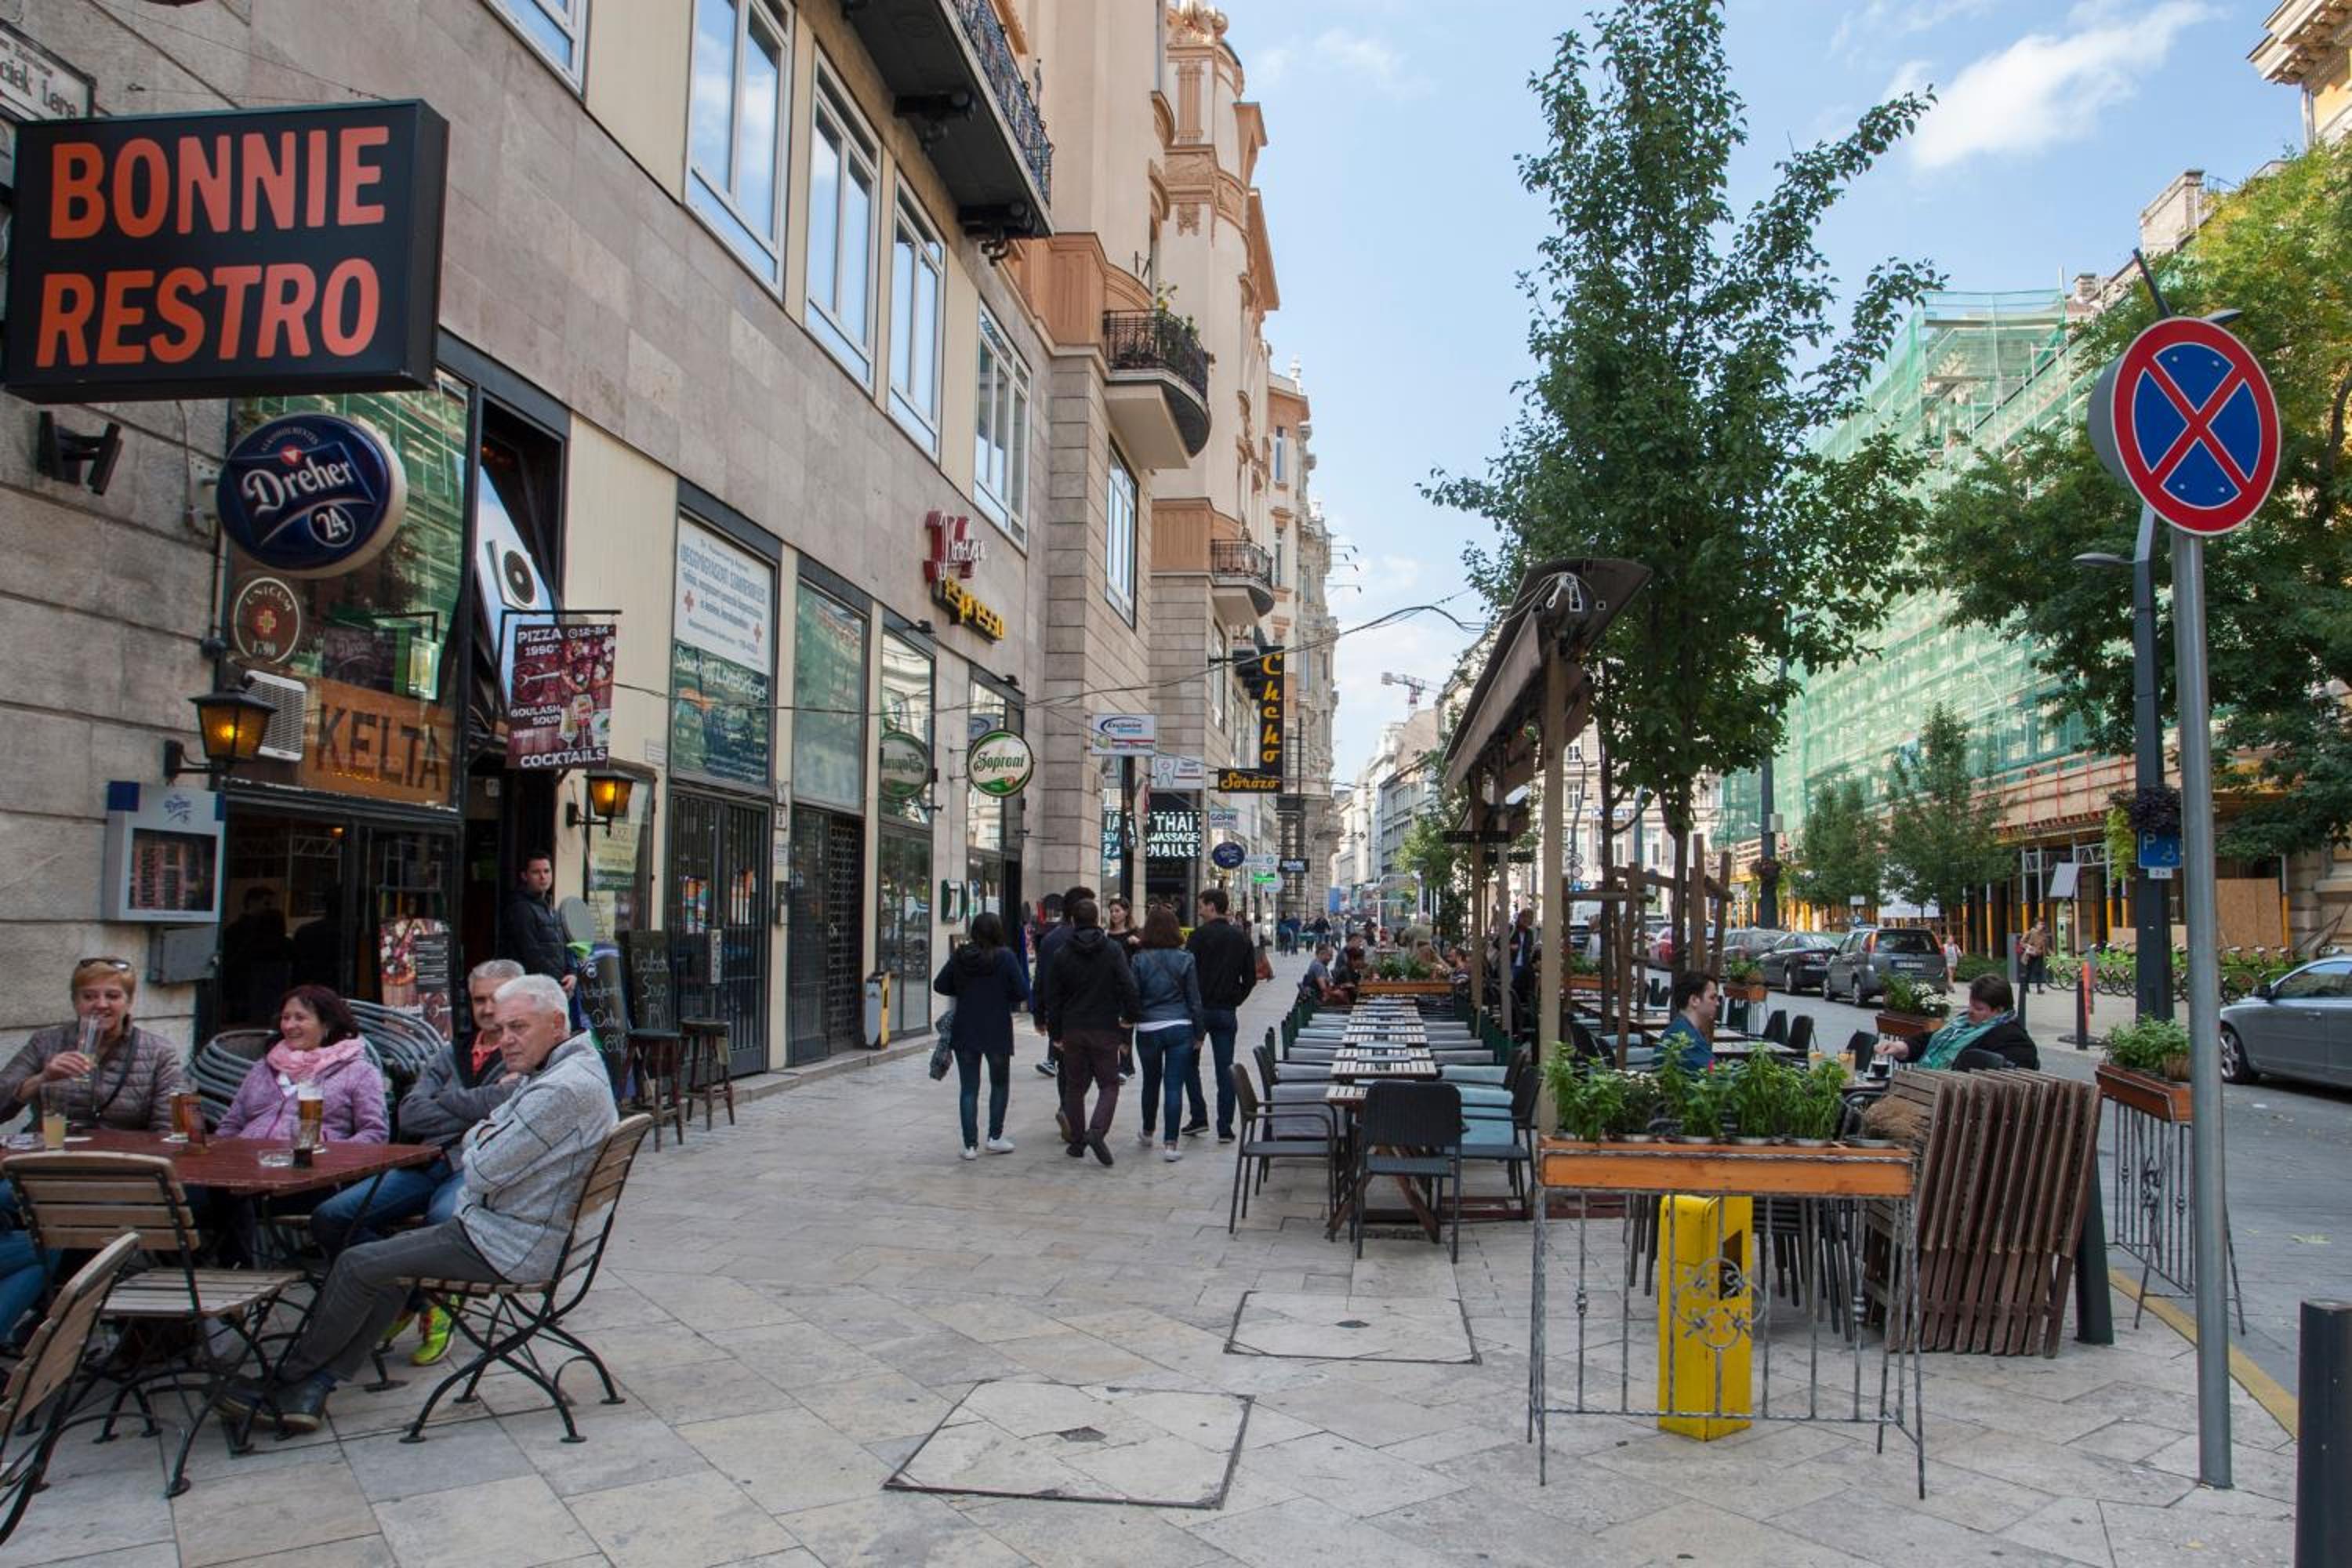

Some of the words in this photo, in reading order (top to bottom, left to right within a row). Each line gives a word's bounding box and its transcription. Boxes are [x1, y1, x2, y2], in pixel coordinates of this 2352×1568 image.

[50, 126, 390, 240] BONNIE
[35, 258, 380, 367] RESTRO
[241, 455, 354, 516] Dreher
[315, 507, 350, 539] 24
[245, 585, 292, 612] UNICUM
[517, 628, 562, 644] PIZZA
[510, 704, 561, 717] GOULASH
[532, 714, 560, 725] SOUP
[314, 702, 442, 791] KELTA
[521, 749, 607, 768] COCKTAILS
[973, 750, 1025, 772] Soproni
[1154, 815, 1192, 832] THAI
[1150, 832, 1199, 843] MASSAGE
[2143, 833, 2157, 851] P
[1149, 843, 1196, 857] NAILS
